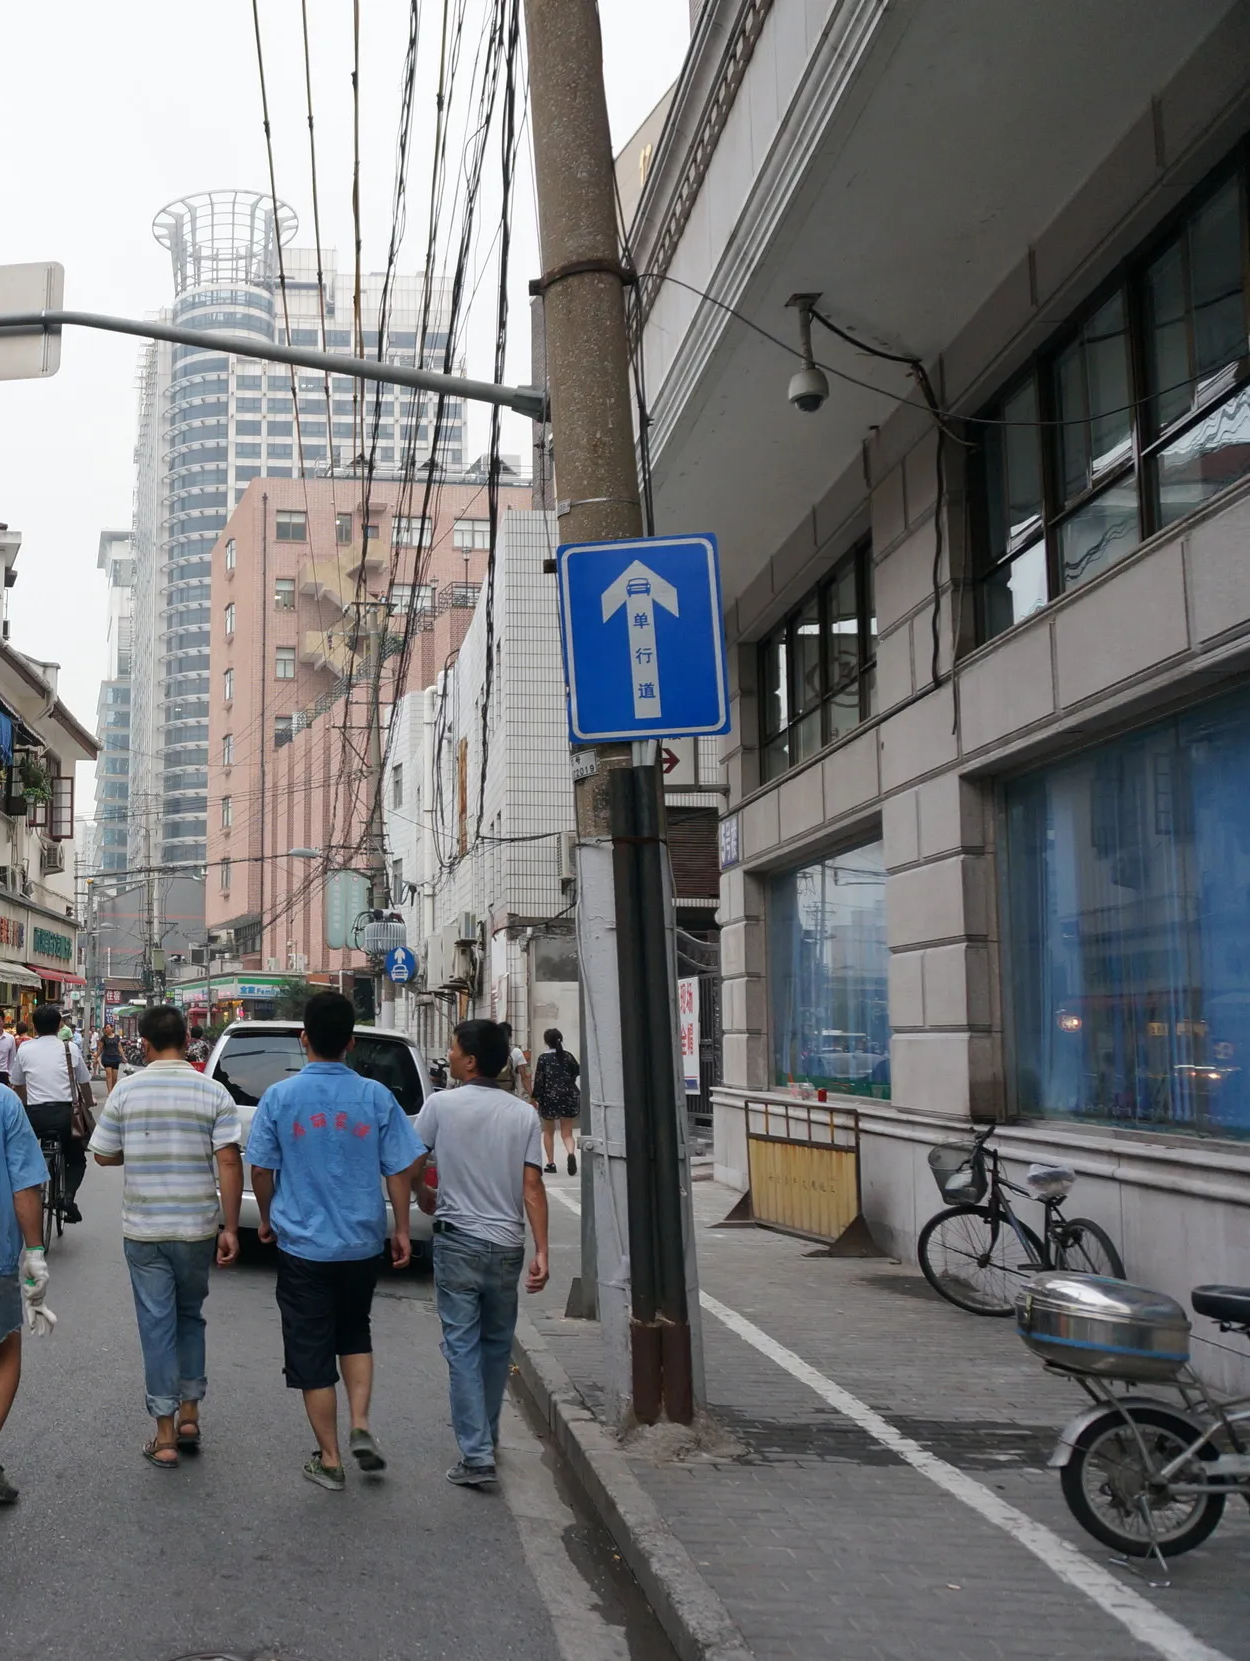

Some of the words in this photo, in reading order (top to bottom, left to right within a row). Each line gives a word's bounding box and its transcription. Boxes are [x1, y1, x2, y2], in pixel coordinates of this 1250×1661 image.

[633, 612, 656, 699] 单行道
[106, 990, 121, 1001] 住宿
[240, 985, 255, 995] 全家
